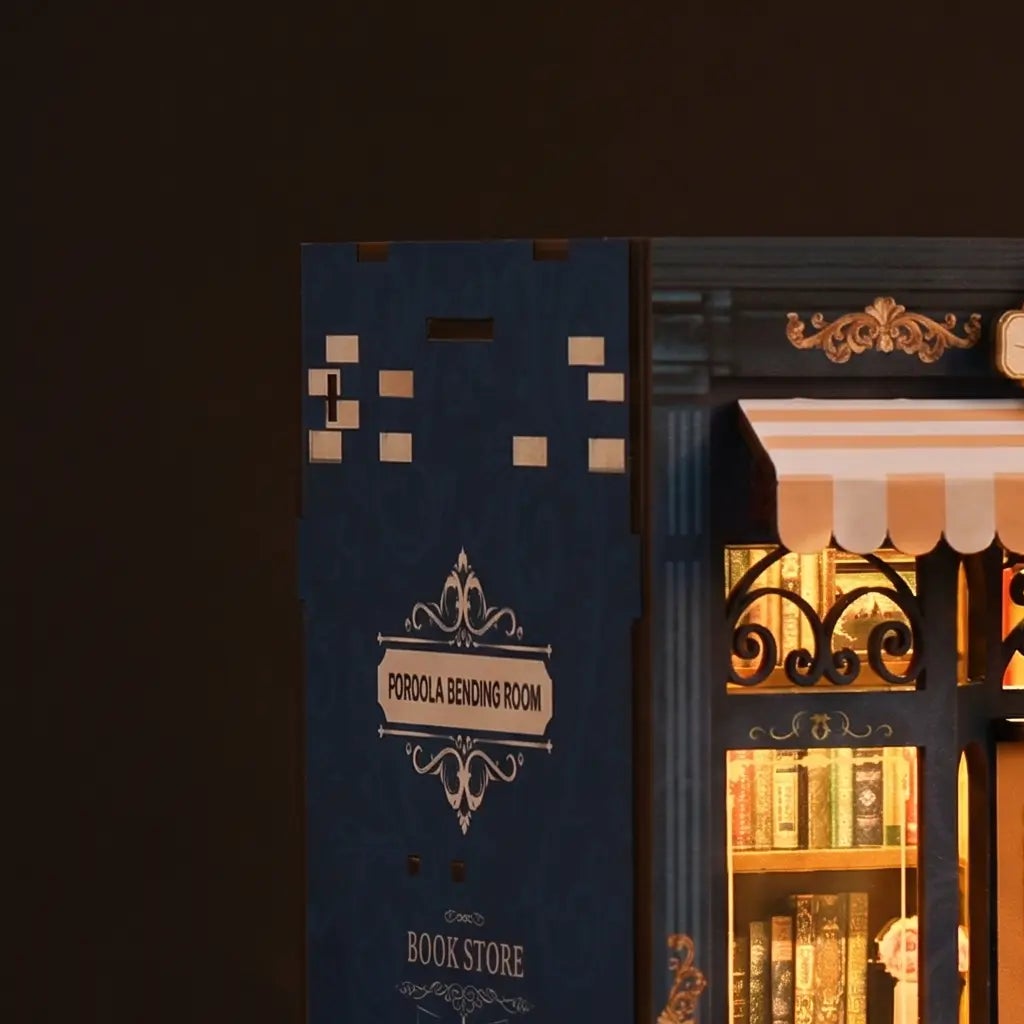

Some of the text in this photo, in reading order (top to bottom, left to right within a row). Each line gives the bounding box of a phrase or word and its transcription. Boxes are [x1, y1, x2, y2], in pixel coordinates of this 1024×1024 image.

[447, 677, 501, 709] BENDING
[503, 681, 542, 712] ROOM
[407, 930, 524, 978] BOOK STORE
